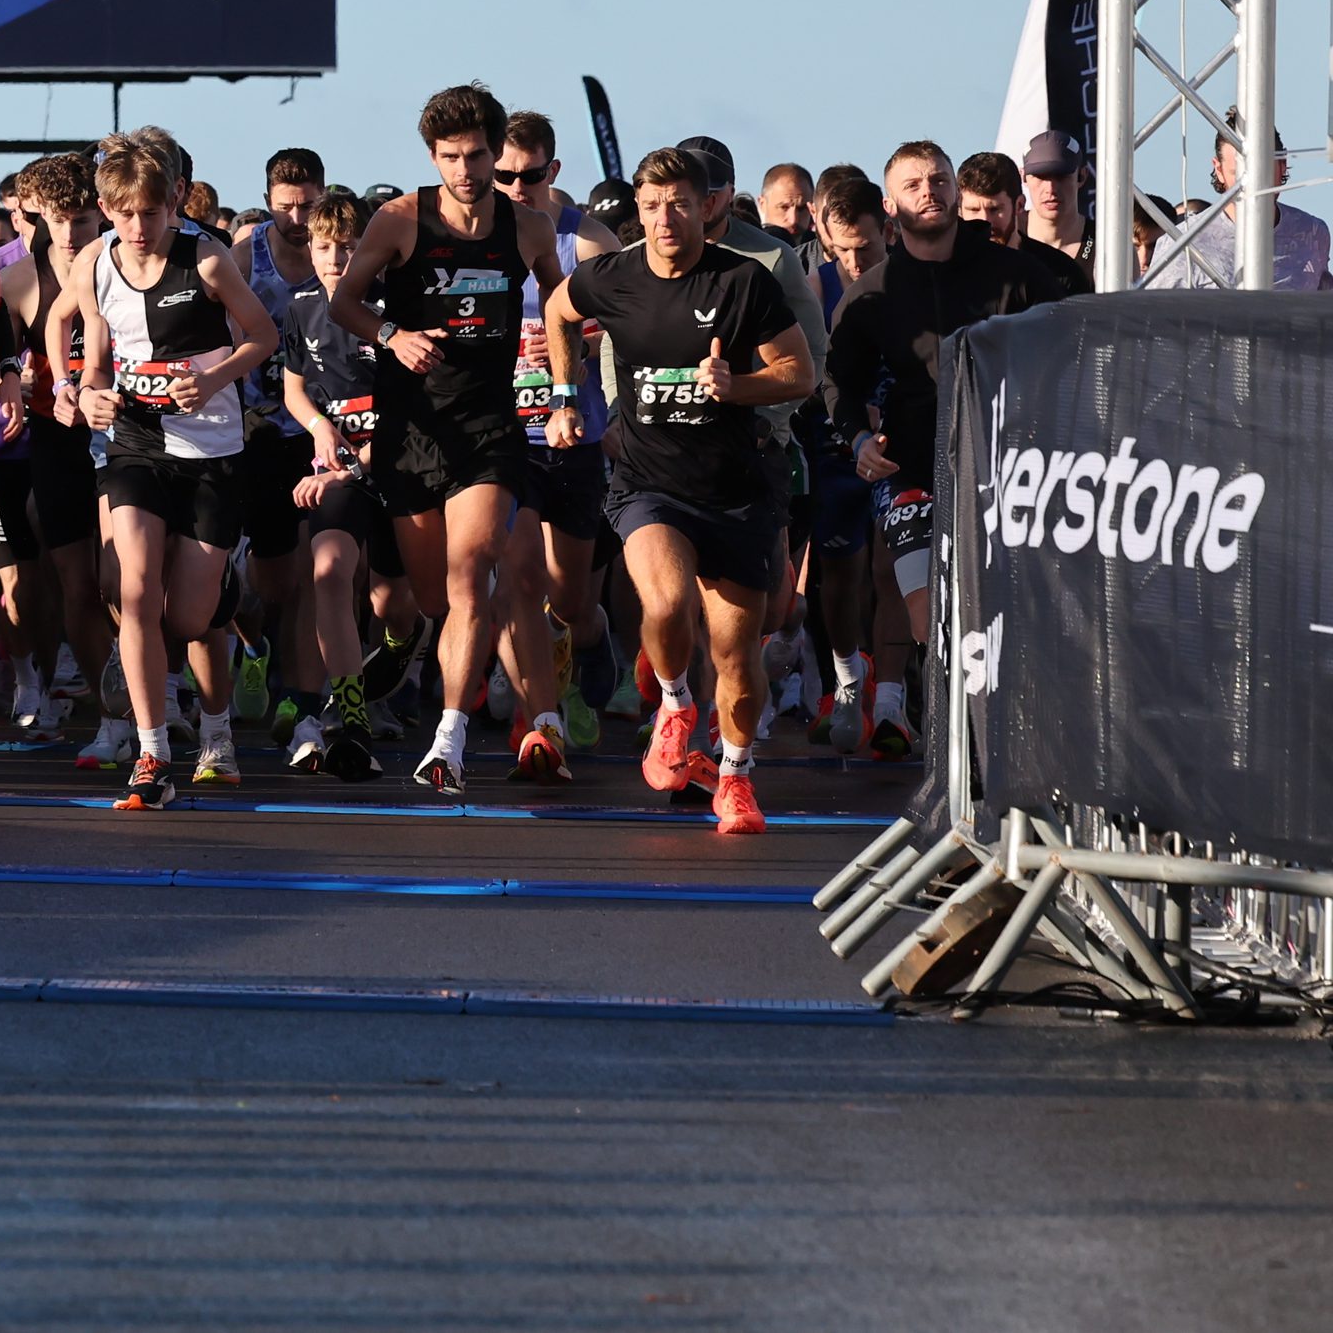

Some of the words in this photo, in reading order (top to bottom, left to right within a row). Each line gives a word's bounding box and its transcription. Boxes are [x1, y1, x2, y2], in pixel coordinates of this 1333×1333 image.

[468, 280, 502, 291] HALF
[458, 296, 476, 317] 3
[516, 387, 551, 408] 03
[641, 383, 710, 405] 6755
[333, 411, 380, 433] 702
